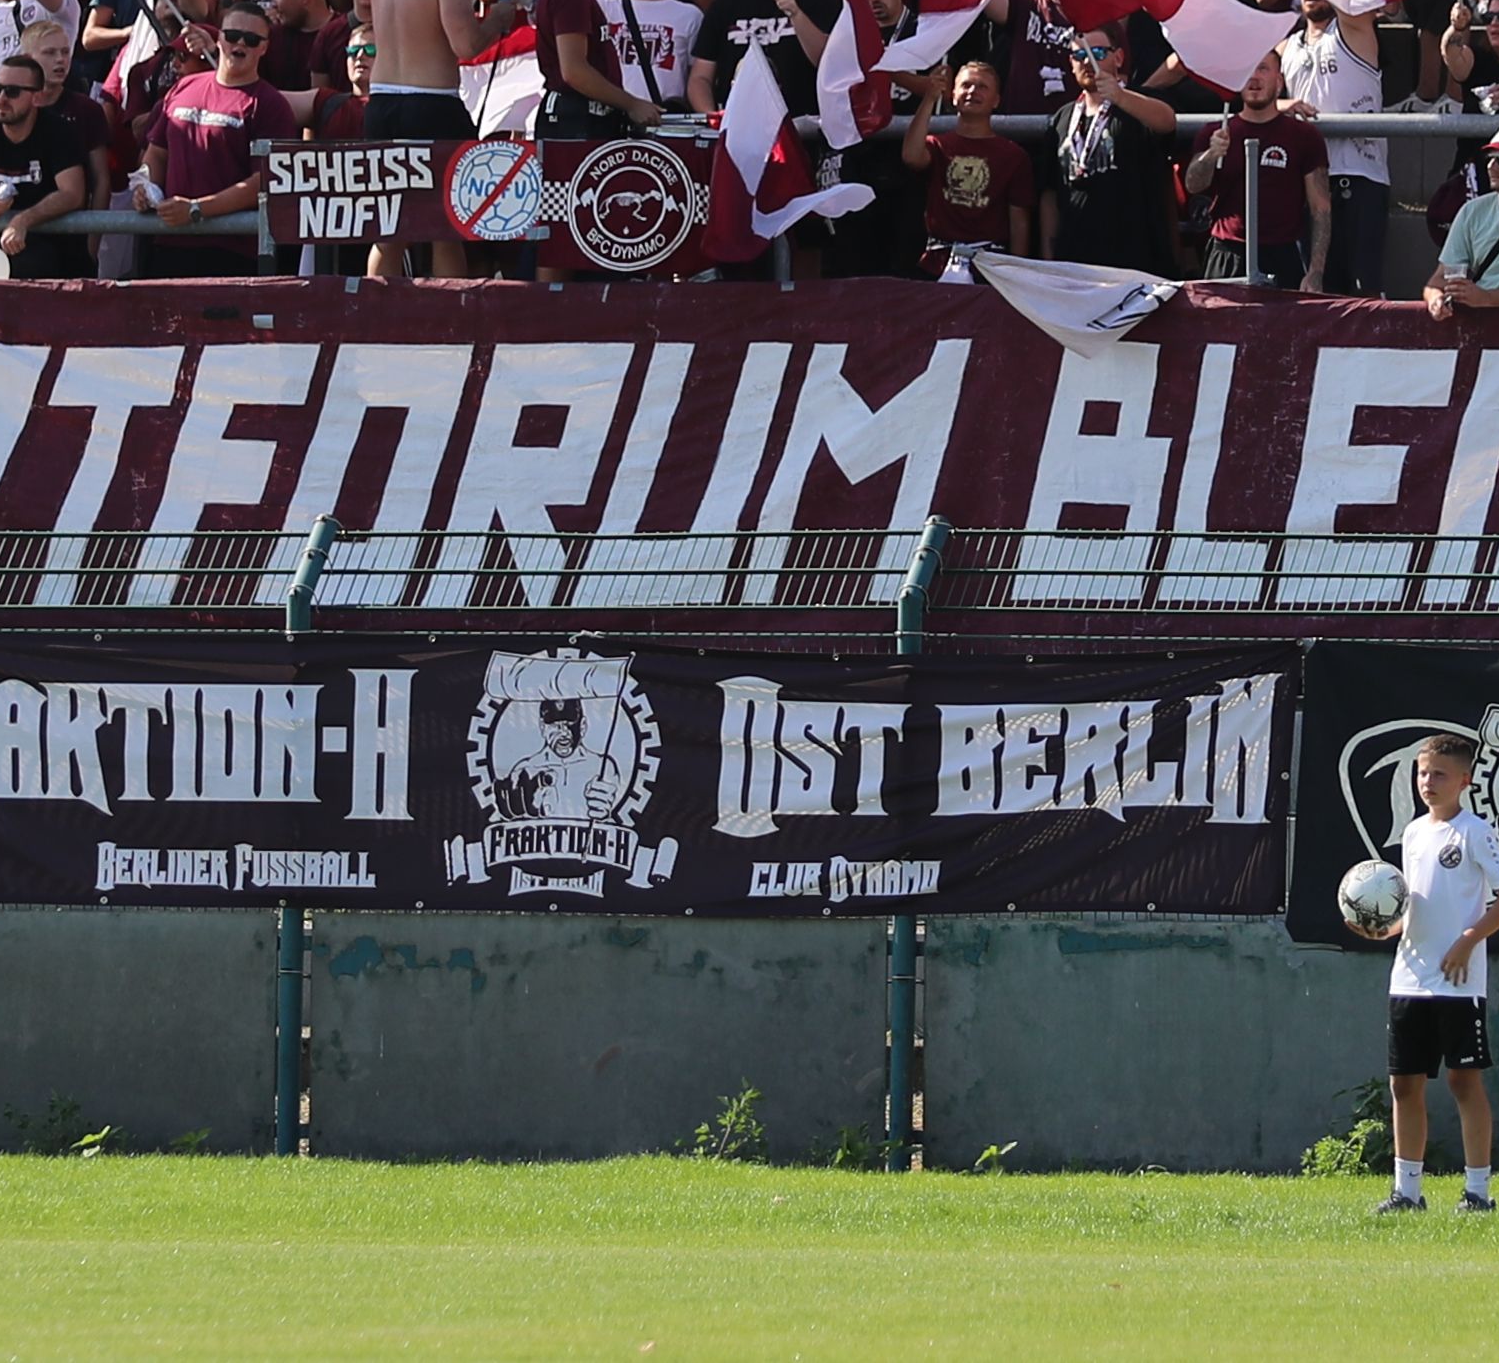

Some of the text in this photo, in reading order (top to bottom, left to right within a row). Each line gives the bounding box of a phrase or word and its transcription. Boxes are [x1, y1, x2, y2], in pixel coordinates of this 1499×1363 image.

[269, 147, 434, 194] SCHEISS
[632, 149, 678, 187] DACHSE
[299, 193, 403, 239] NOFV
[586, 227, 667, 260] BFC DYNAMO
[712, 672, 1283, 838] OST BERLIN
[95, 841, 377, 891] BERLINER FUSSBALL
[508, 866, 605, 898] OST BERLIN
[747, 854, 942, 903] CLUB DYNAMO
